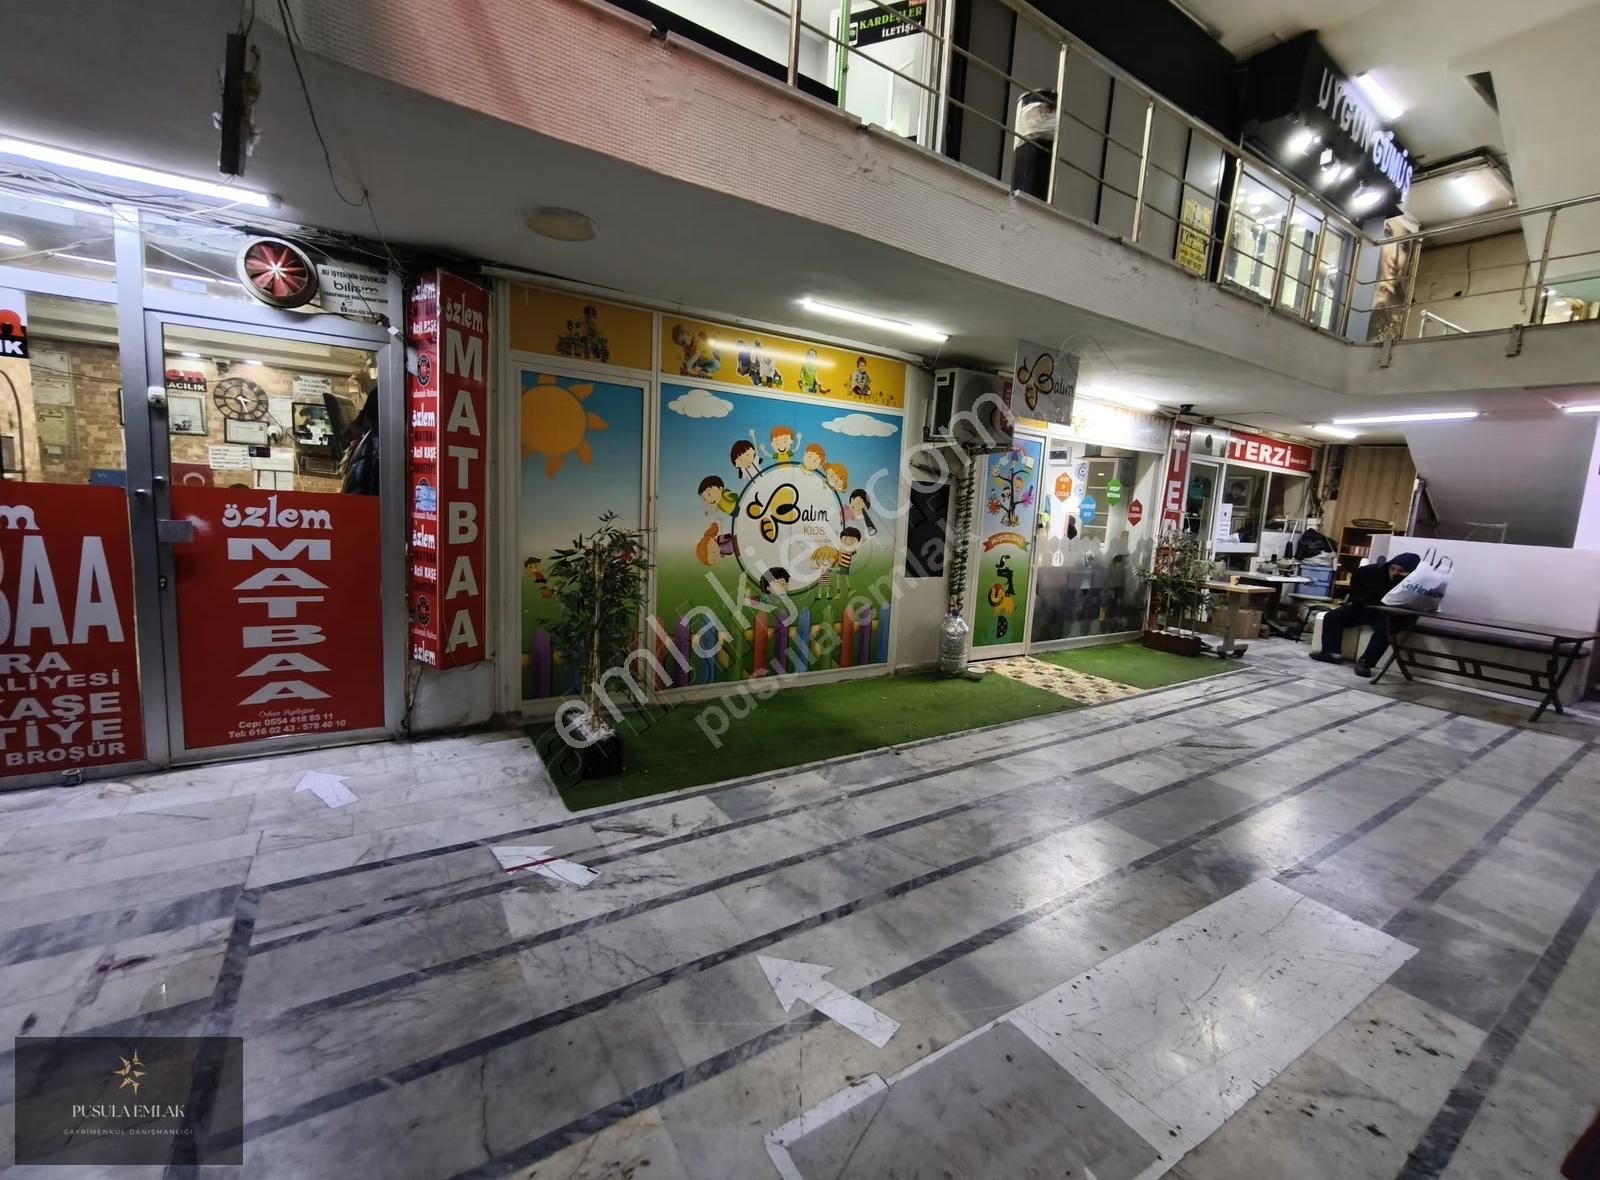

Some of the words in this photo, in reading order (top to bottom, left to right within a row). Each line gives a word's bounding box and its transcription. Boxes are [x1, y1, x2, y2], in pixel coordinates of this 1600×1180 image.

[1317, 67, 1373, 153] UYGUN
[445, 292, 483, 334] özlem
[412, 402, 436, 428] özlem
[1230, 438, 1291, 467] TERZİ
[445, 327, 483, 653] MATBAA
[222, 494, 334, 529] özlem
[412, 524, 436, 550] özlem
[803, 525, 826, 537] KIDS
[413, 564, 424, 577] Acil
[424, 567, 437, 583] KAŞE
[0, 535, 125, 647] AA
[227, 537, 333, 706] MATBAA
[413, 640, 436, 666] özlem
[0, 668, 120, 692] LİYESİ
[0, 691, 122, 722] AŞE
[264, 718, 288, 727] 0554
[323, 712, 334, 720] 11
[228, 731, 247, 739] Tel:
[322, 720, 333, 728] 40
[336, 719, 347, 727] 10
[6, 741, 126, 767] BROŞÜR
